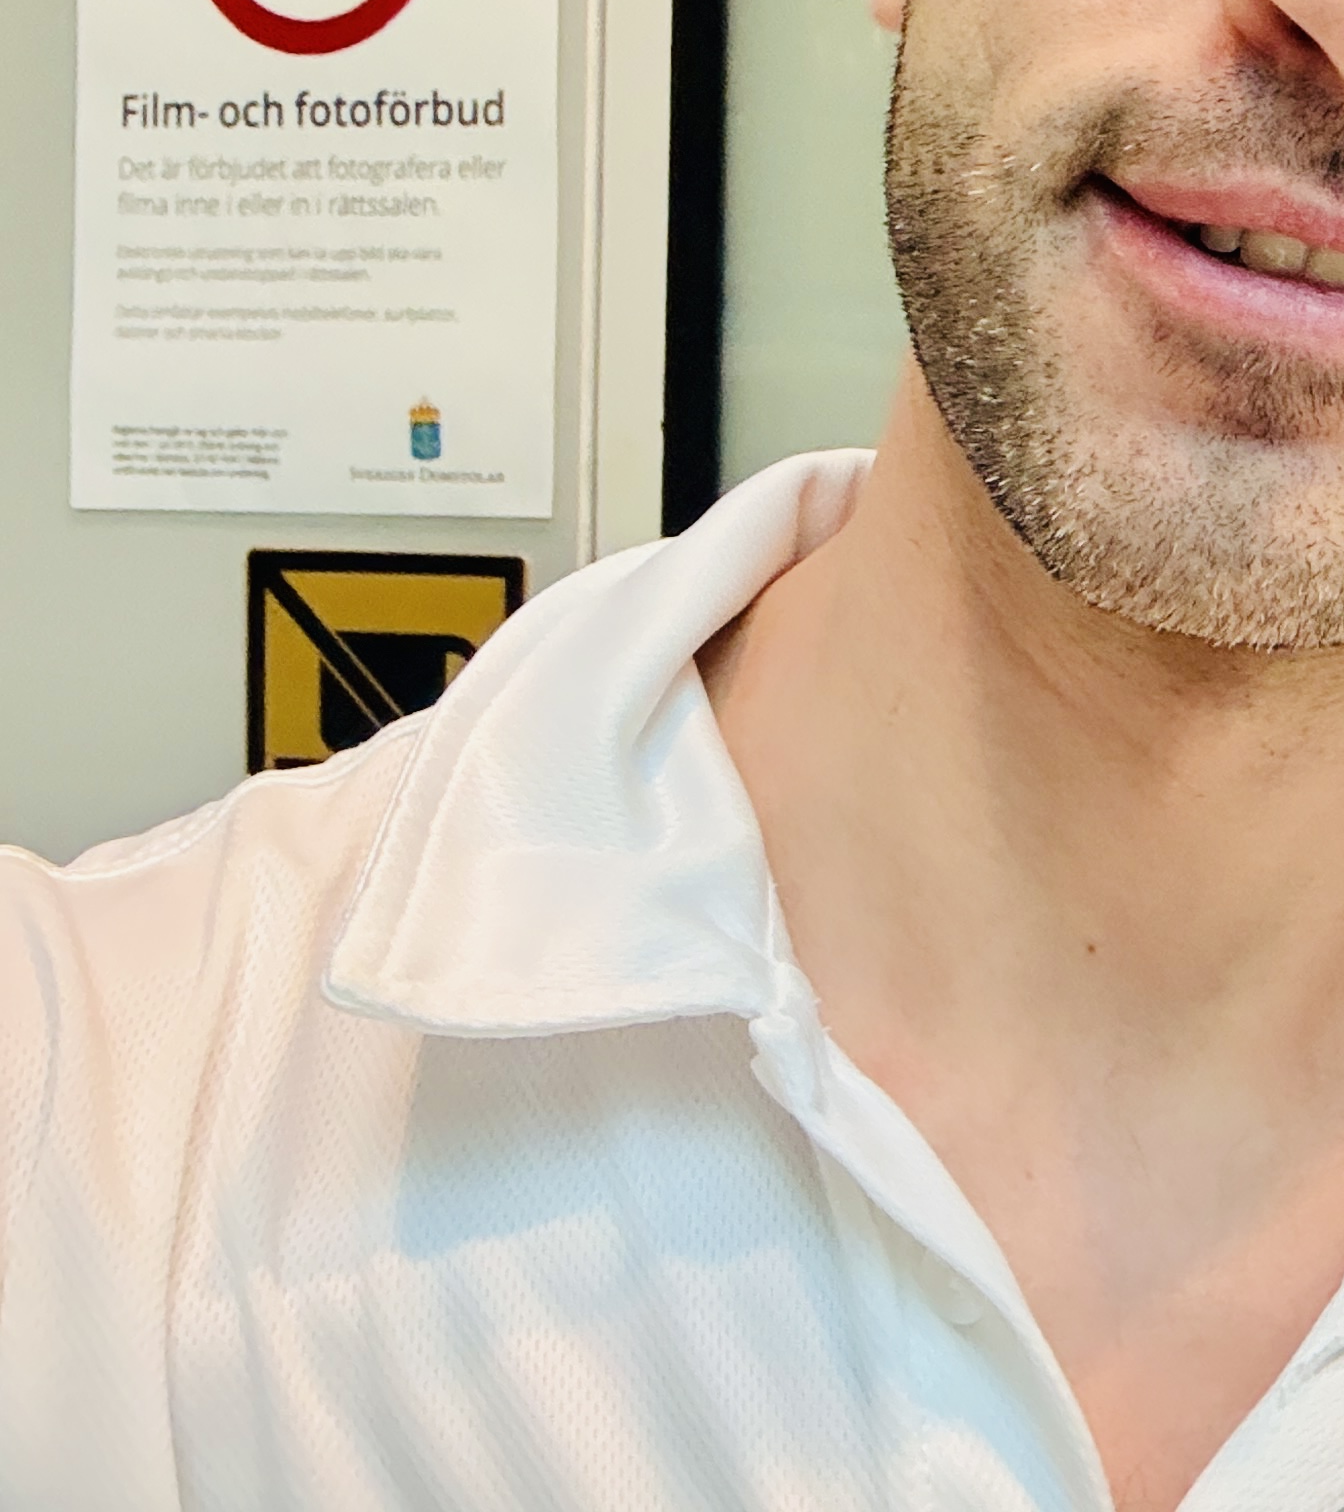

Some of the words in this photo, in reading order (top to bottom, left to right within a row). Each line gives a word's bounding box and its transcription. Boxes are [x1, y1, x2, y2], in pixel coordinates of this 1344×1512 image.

[122, 93, 209, 128] Film-
[218, 92, 283, 129] och
[294, 89, 504, 128] fotoförbud
[118, 156, 155, 181] Det
[187, 156, 287, 187] förbjudet
[291, 159, 323, 180] att
[327, 155, 452, 187] fotografera
[457, 155, 506, 180] eller
